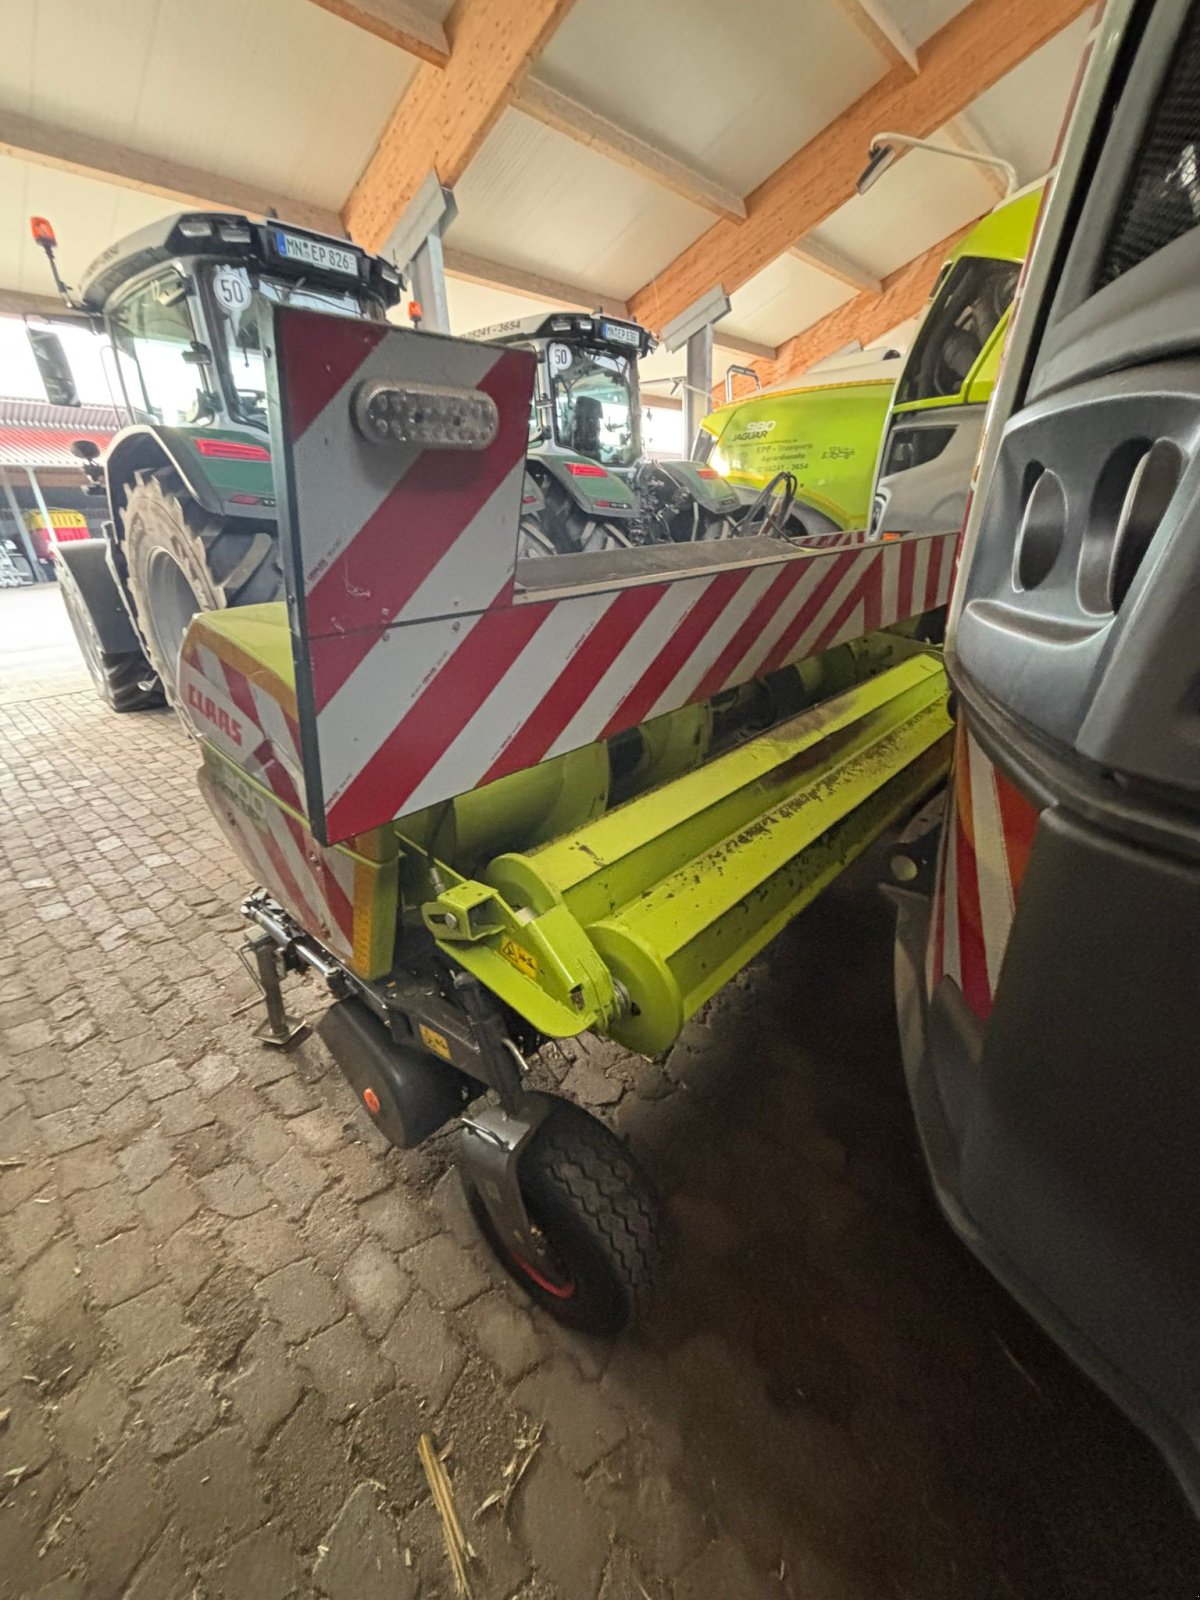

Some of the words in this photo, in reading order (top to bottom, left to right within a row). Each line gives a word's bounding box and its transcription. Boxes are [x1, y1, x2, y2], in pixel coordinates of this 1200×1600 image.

[286, 238, 303, 257] MN
[311, 244, 326, 263] EP
[328, 249, 349, 270] 826
[220, 279, 244, 303] 50
[555, 349, 567, 365] 50
[733, 431, 768, 441] JAGUAR
[188, 684, 242, 746] CLAAS
